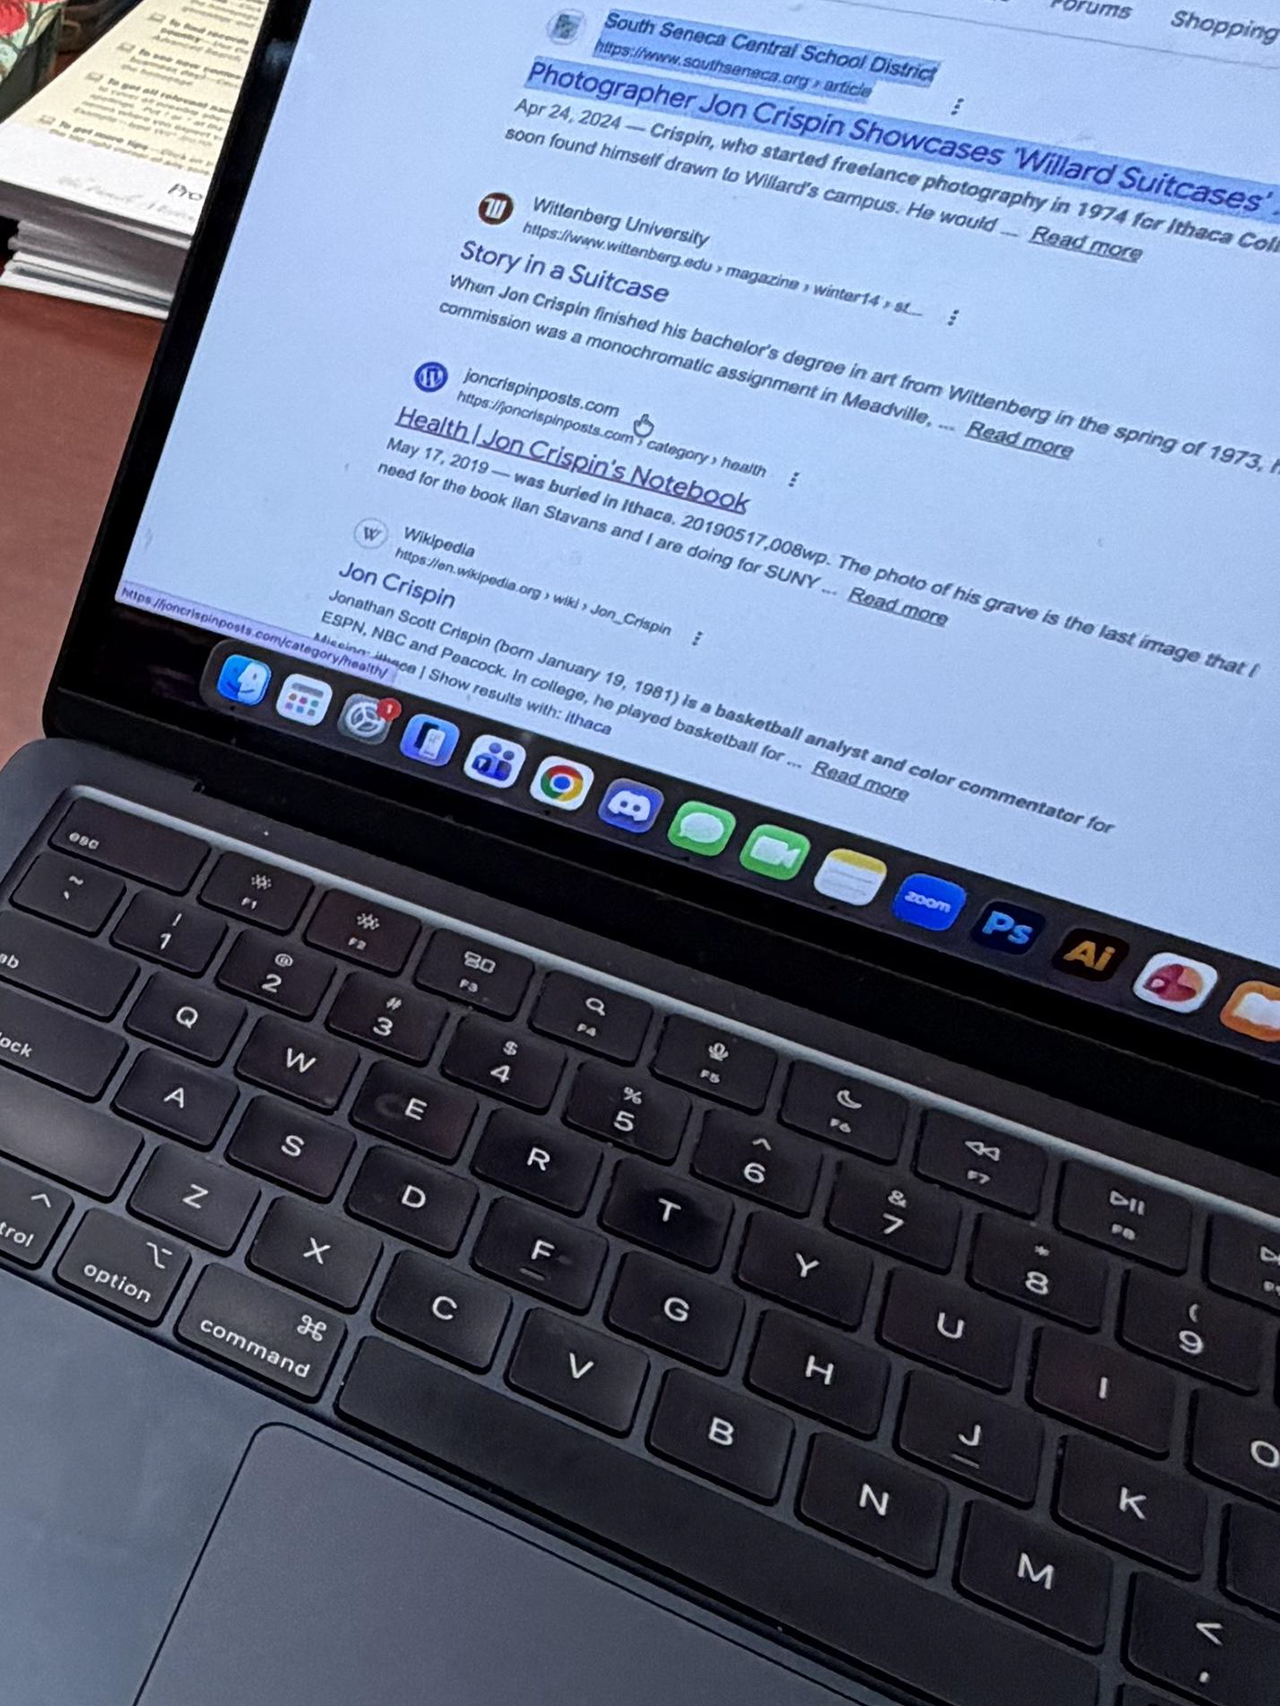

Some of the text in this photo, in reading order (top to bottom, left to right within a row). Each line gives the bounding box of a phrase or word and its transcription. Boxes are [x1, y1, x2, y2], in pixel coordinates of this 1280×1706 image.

[1170, 10, 1280, 46] Shopping
[604, 9, 943, 84] South Seneca Central School District
[528, 62, 697, 108] Photographer
[698, 93, 747, 120] Jon
[752, 101, 845, 140] Crispin
[849, 119, 1003, 165] Showcases
[534, 197, 711, 250] Wittenberg University
[460, 240, 670, 303] Story in a Suitcase
[462, 367, 620, 418] joncrispinposts.com
[397, 406, 468, 441] Health
[481, 430, 524, 456] Jon
[529, 439, 625, 482] Crispin's
[630, 466, 751, 512] Notebook
[405, 527, 476, 558] Wikipedia
[338, 562, 456, 609] Jon Crispin
[69, 832, 99, 850] esc
[904, 891, 952, 913] zoom
[982, 911, 1033, 944] Ps
[1063, 941, 1116, 971] Ai
[176, 1006, 199, 1029] Q
[286, 1047, 317, 1073] W
[164, 1087, 184, 1109] A
[281, 1135, 305, 1157] S
[84, 1264, 151, 1303] option
[200, 1315, 311, 1379] command
[708, 1417, 734, 1446] B
[1017, 1553, 1054, 1590] M
